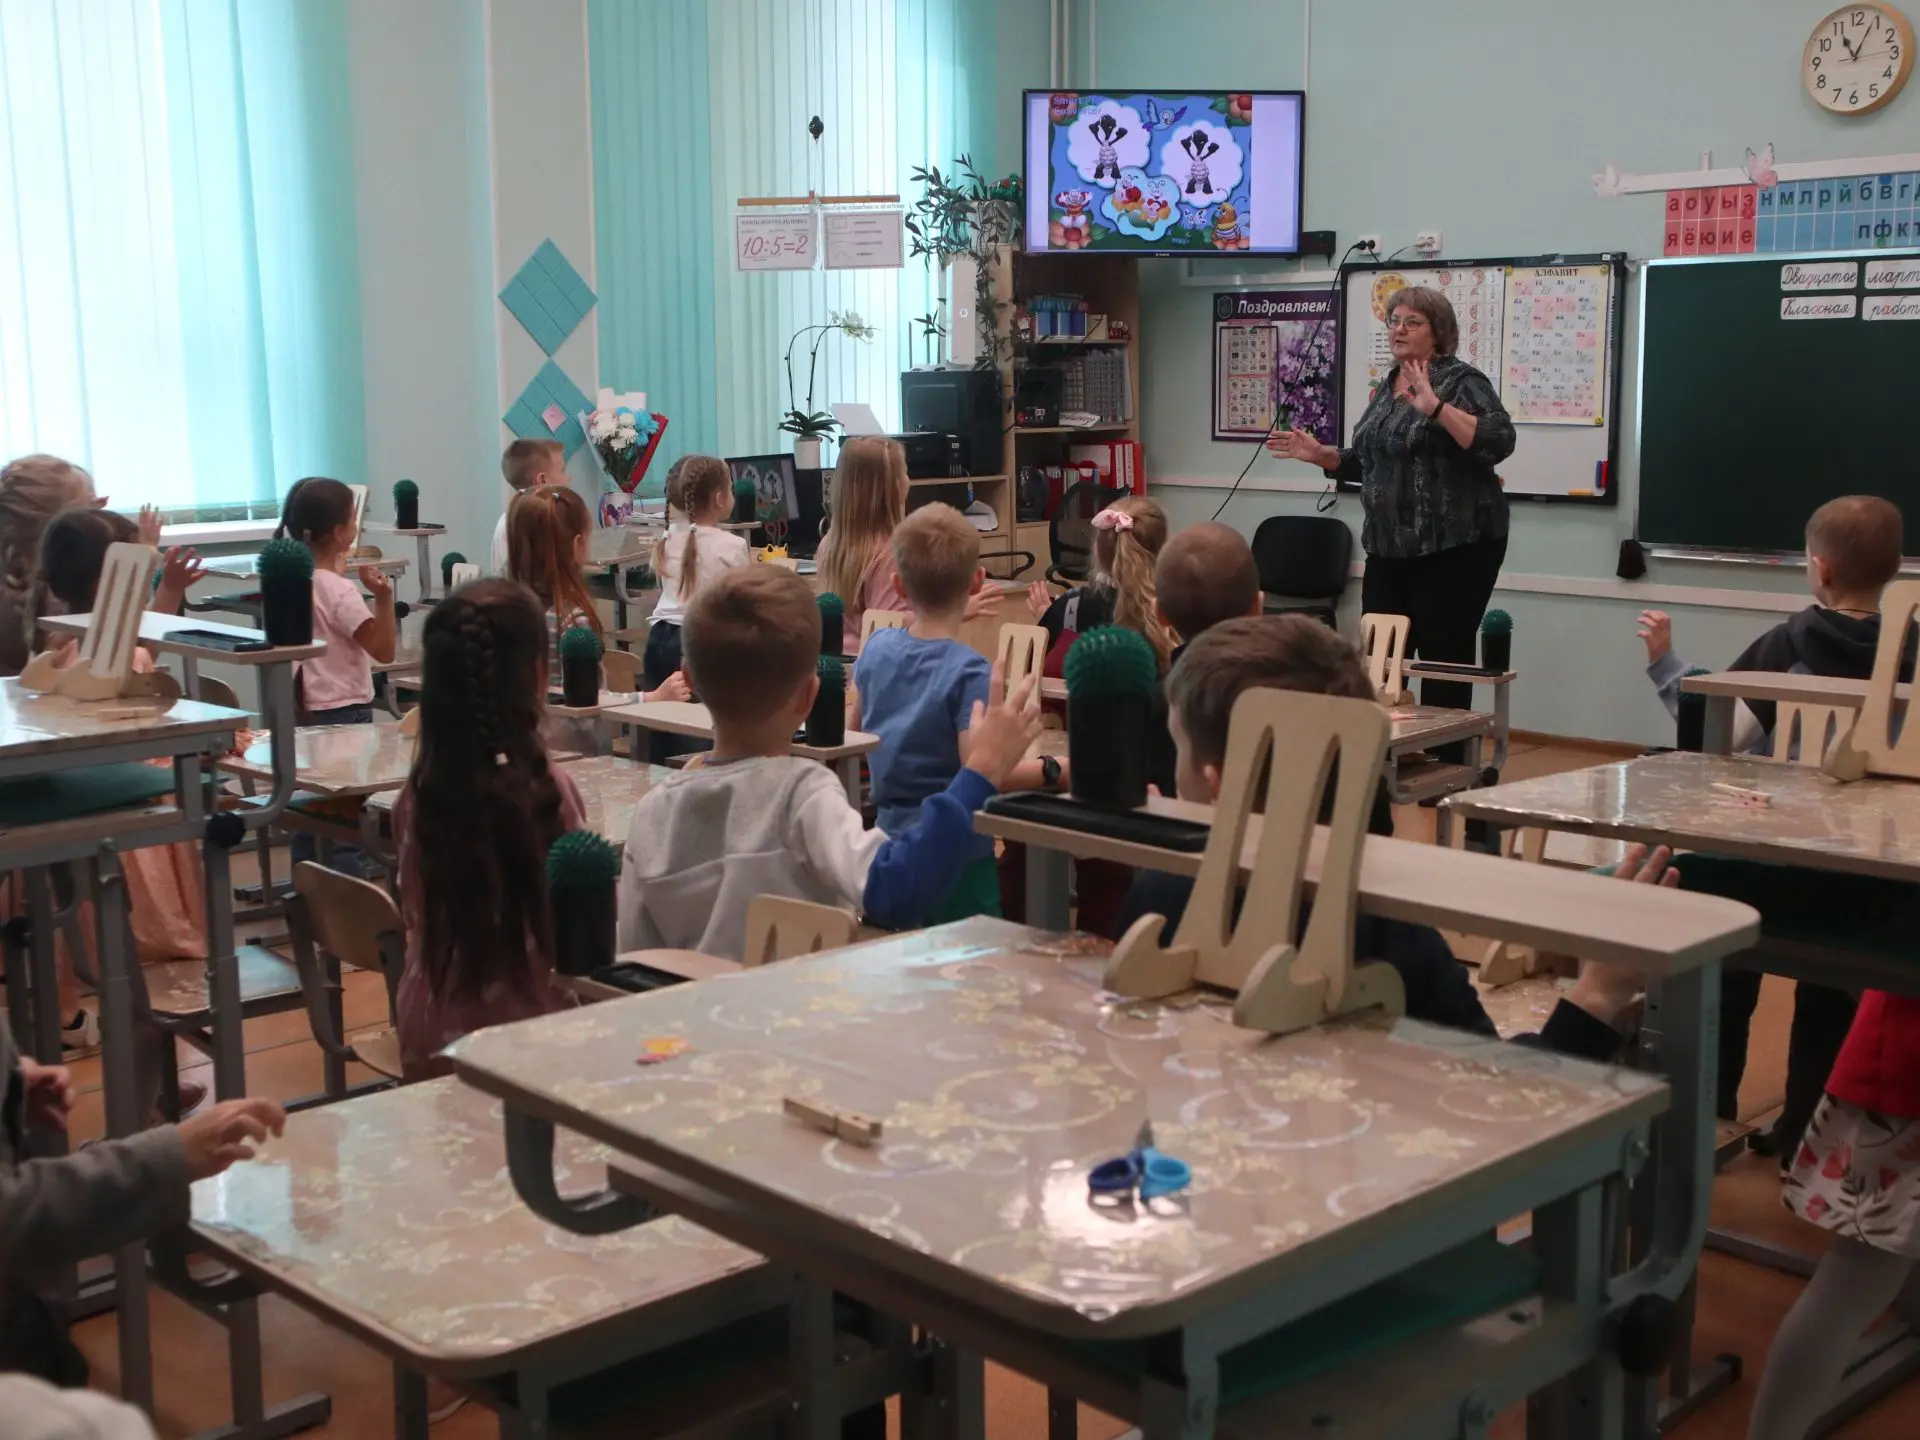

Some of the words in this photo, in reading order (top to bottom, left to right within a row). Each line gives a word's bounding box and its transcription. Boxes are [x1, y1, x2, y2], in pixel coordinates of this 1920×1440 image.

[1850, 11, 1865, 27] 12
[1833, 21, 1844, 36] 11
[1885, 28, 1895, 43] 2
[1819, 37, 1832, 52] 10
[1889, 45, 1899, 60] 3
[1812, 56, 1821, 71] 9
[1882, 65, 1892, 79] 4
[1816, 74, 1826, 89] 8
[1832, 88, 1842, 103] 7
[1849, 90, 1859, 105] 6
[1869, 83, 1878, 98] 5
[1535, 268, 1579, 277] АЛФАВИТ
[1237, 299, 1332, 316] Поздравляем!
[1783, 298, 1849, 315] Классная
